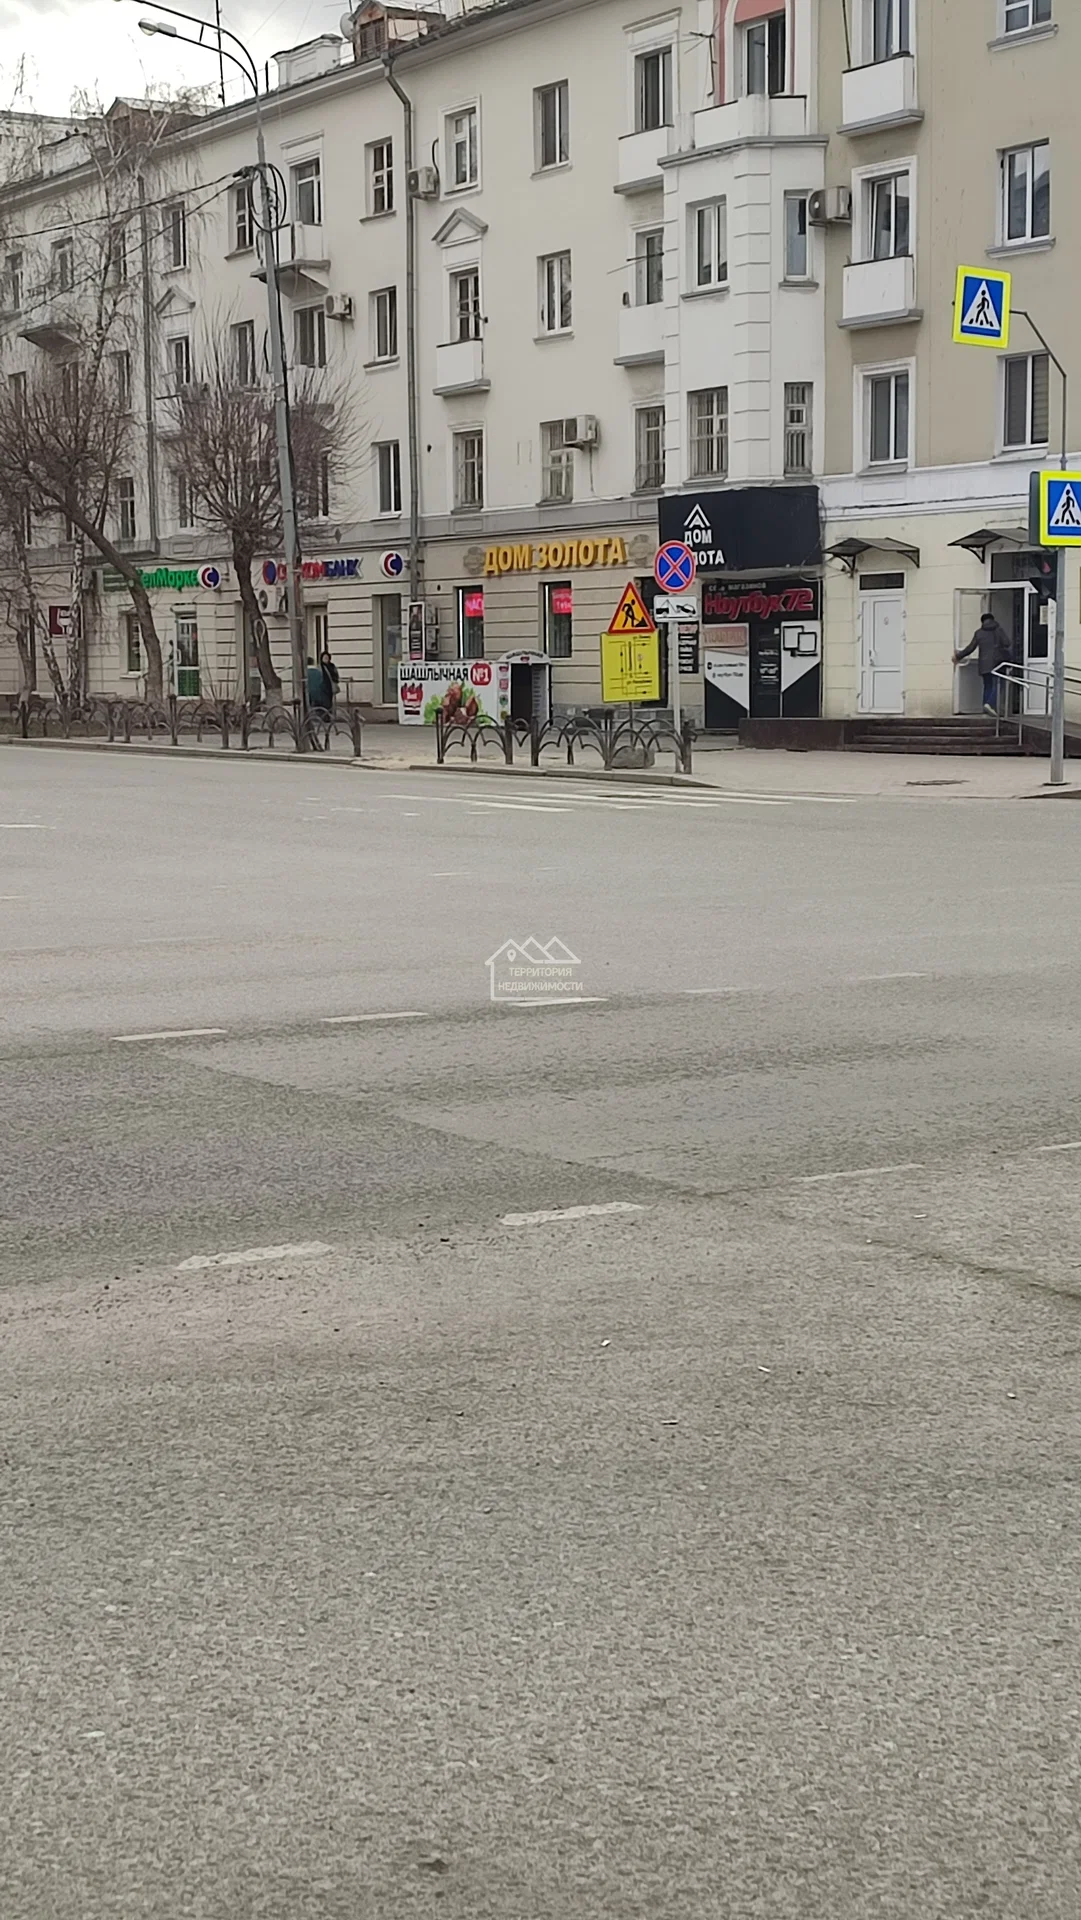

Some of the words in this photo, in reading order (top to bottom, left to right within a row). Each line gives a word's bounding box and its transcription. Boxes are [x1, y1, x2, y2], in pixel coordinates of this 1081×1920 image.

[684, 529, 712, 547] ДОМ
[484, 546, 533, 576] ДОМ
[536, 537, 628, 569] ЗОЛОТА
[692, 549, 725, 565] ЛОТА
[400, 667, 469, 681] ШАШЛЫЧНАЯ
[473, 666, 490, 682] №1
